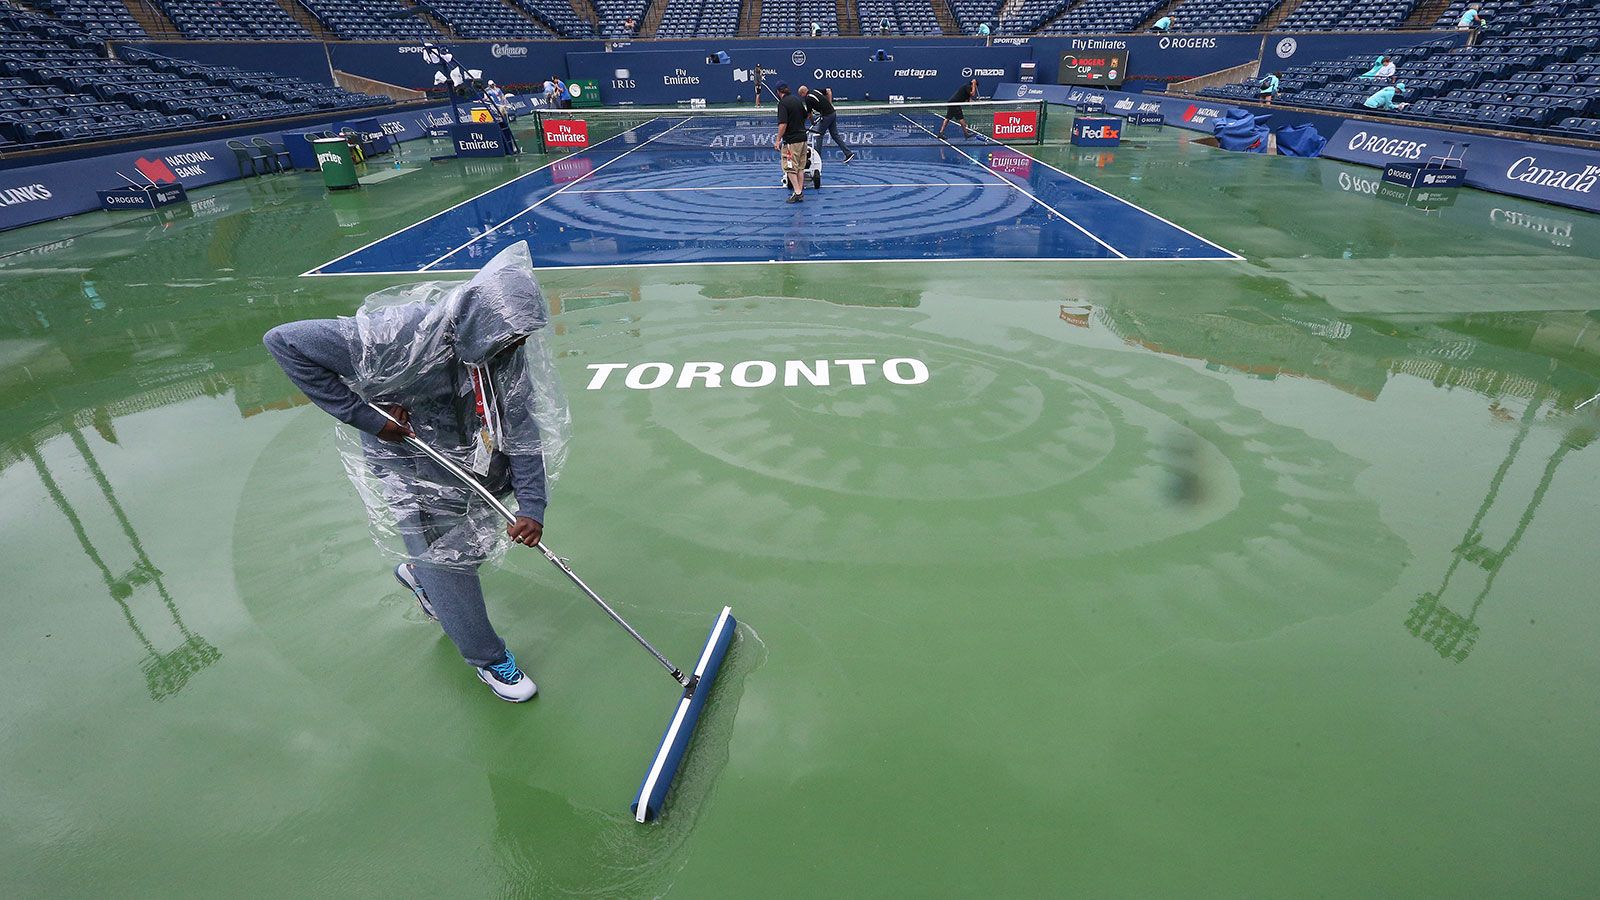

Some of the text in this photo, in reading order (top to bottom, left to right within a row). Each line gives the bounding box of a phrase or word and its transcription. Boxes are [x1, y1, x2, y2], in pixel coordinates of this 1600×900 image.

[1072, 39, 1126, 50] Fly Emirates
[1171, 38, 1216, 48] ROGERS
[1078, 58, 1105, 66] ROGERS
[675, 68, 687, 77] Fly
[825, 68, 863, 79] ROGERS
[612, 79, 636, 89] IRIS
[663, 75, 700, 85] Emirates
[1197, 107, 1220, 117] NATIONAL
[1009, 116, 1021, 125] Fly
[1190, 115, 1206, 124] BANK
[559, 125, 571, 134] Fly
[995, 124, 1033, 134] Emirates
[1081, 125, 1119, 139] FedEx
[470, 132, 483, 141] Fly
[546, 131, 586, 142] Emirates
[709, 134, 746, 148] ATP
[459, 140, 499, 150] Emirates
[1362, 135, 1427, 160] ROGERS
[165, 150, 214, 167] NATIONAL
[175, 164, 206, 178] BANK
[1392, 169, 1412, 180] ROGERS
[1507, 156, 1598, 193] Canada
[115, 196, 144, 204] ROGERS
[585, 357, 931, 391] TORONTO
